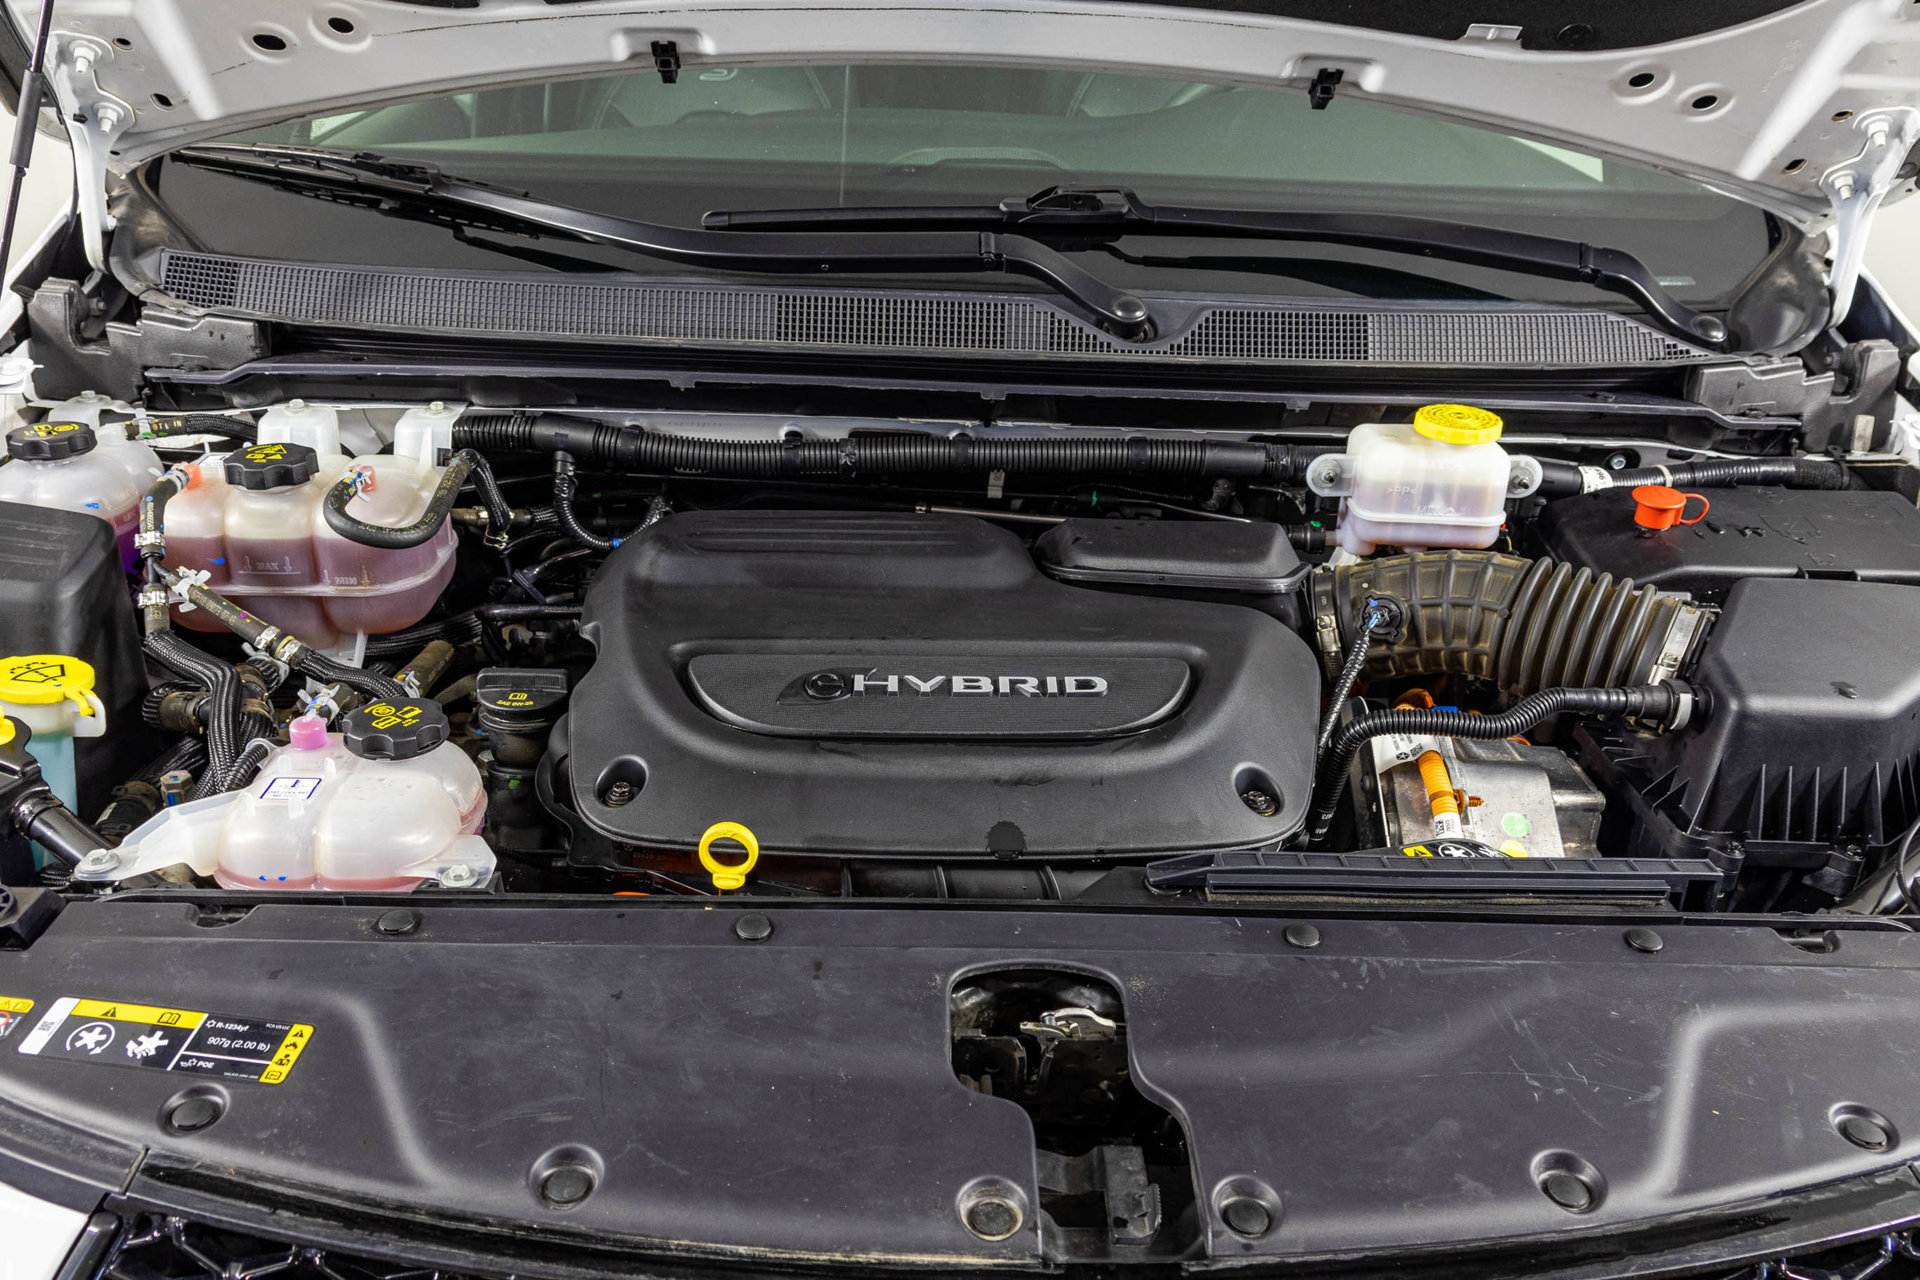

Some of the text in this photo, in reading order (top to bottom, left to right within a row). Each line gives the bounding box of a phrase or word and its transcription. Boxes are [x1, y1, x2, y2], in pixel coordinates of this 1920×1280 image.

[215, 1022, 250, 1032] R-1234yf
[207, 1036, 271, 1052] 907g (2.00 lb)
[196, 1061, 215, 1069] POE
